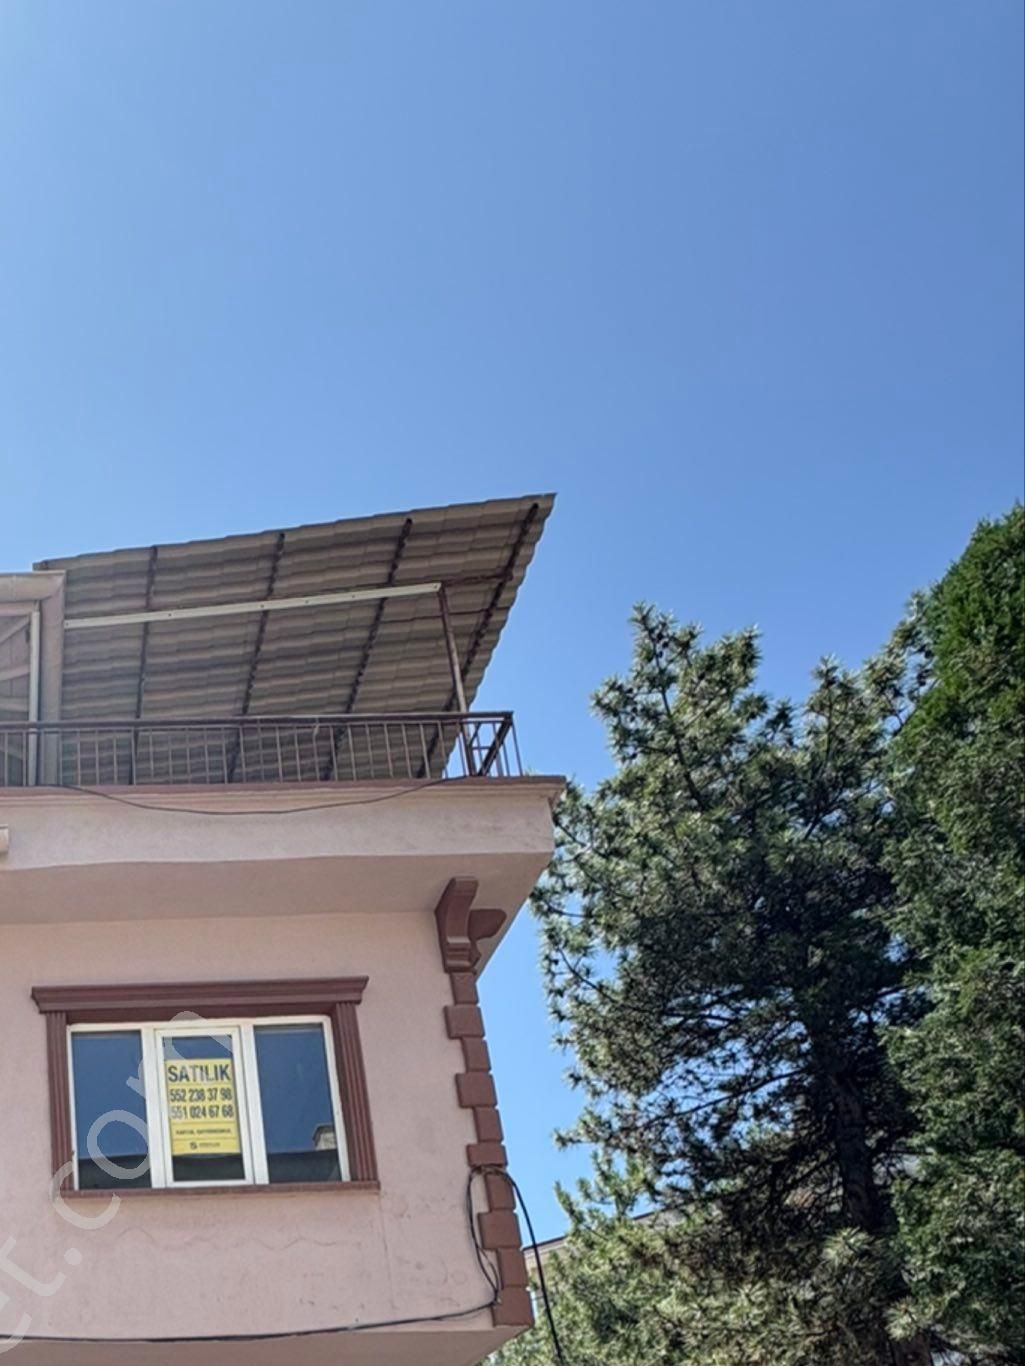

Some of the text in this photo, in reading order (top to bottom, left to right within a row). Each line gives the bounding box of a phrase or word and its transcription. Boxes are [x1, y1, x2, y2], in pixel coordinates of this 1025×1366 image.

[167, 1064, 231, 1082] SATILIK
[169, 1088, 187, 1102] 552
[207, 1088, 218, 1101] 37
[189, 1105, 207, 1118] 024
[208, 1105, 219, 1118] 67
